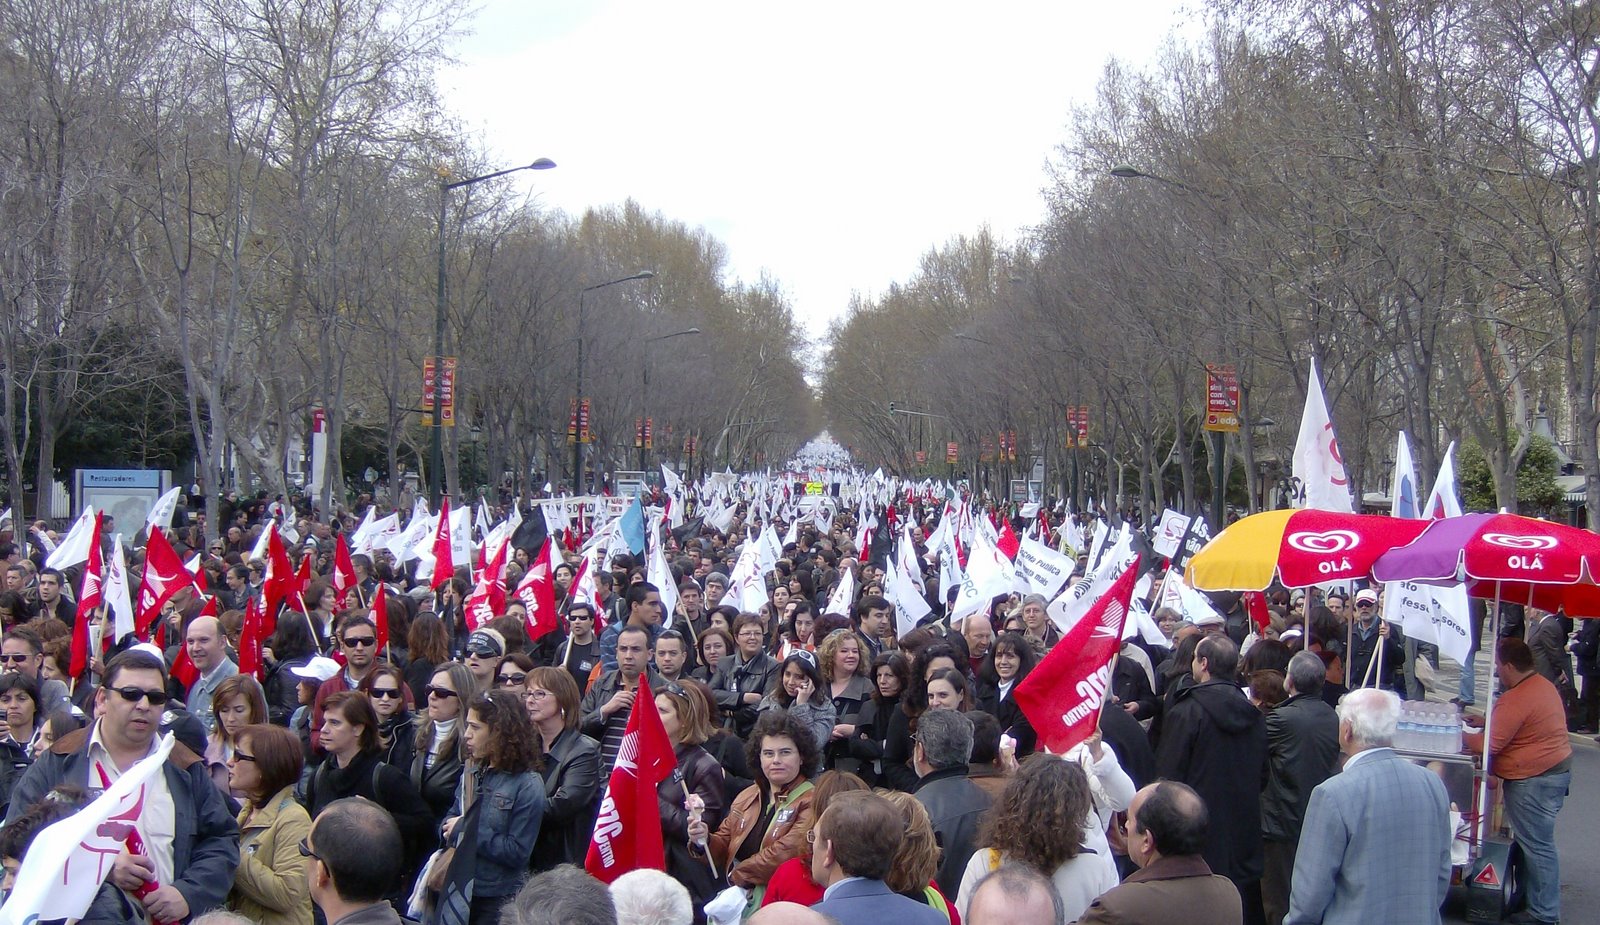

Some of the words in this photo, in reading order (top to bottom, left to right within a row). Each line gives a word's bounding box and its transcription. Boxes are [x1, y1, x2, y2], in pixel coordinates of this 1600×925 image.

[1220, 416, 1237, 426] edp
[90, 474, 136, 482] Restauradores
[1318, 556, 1352, 574] OLÁ
[1508, 552, 1544, 570] OLÁ
